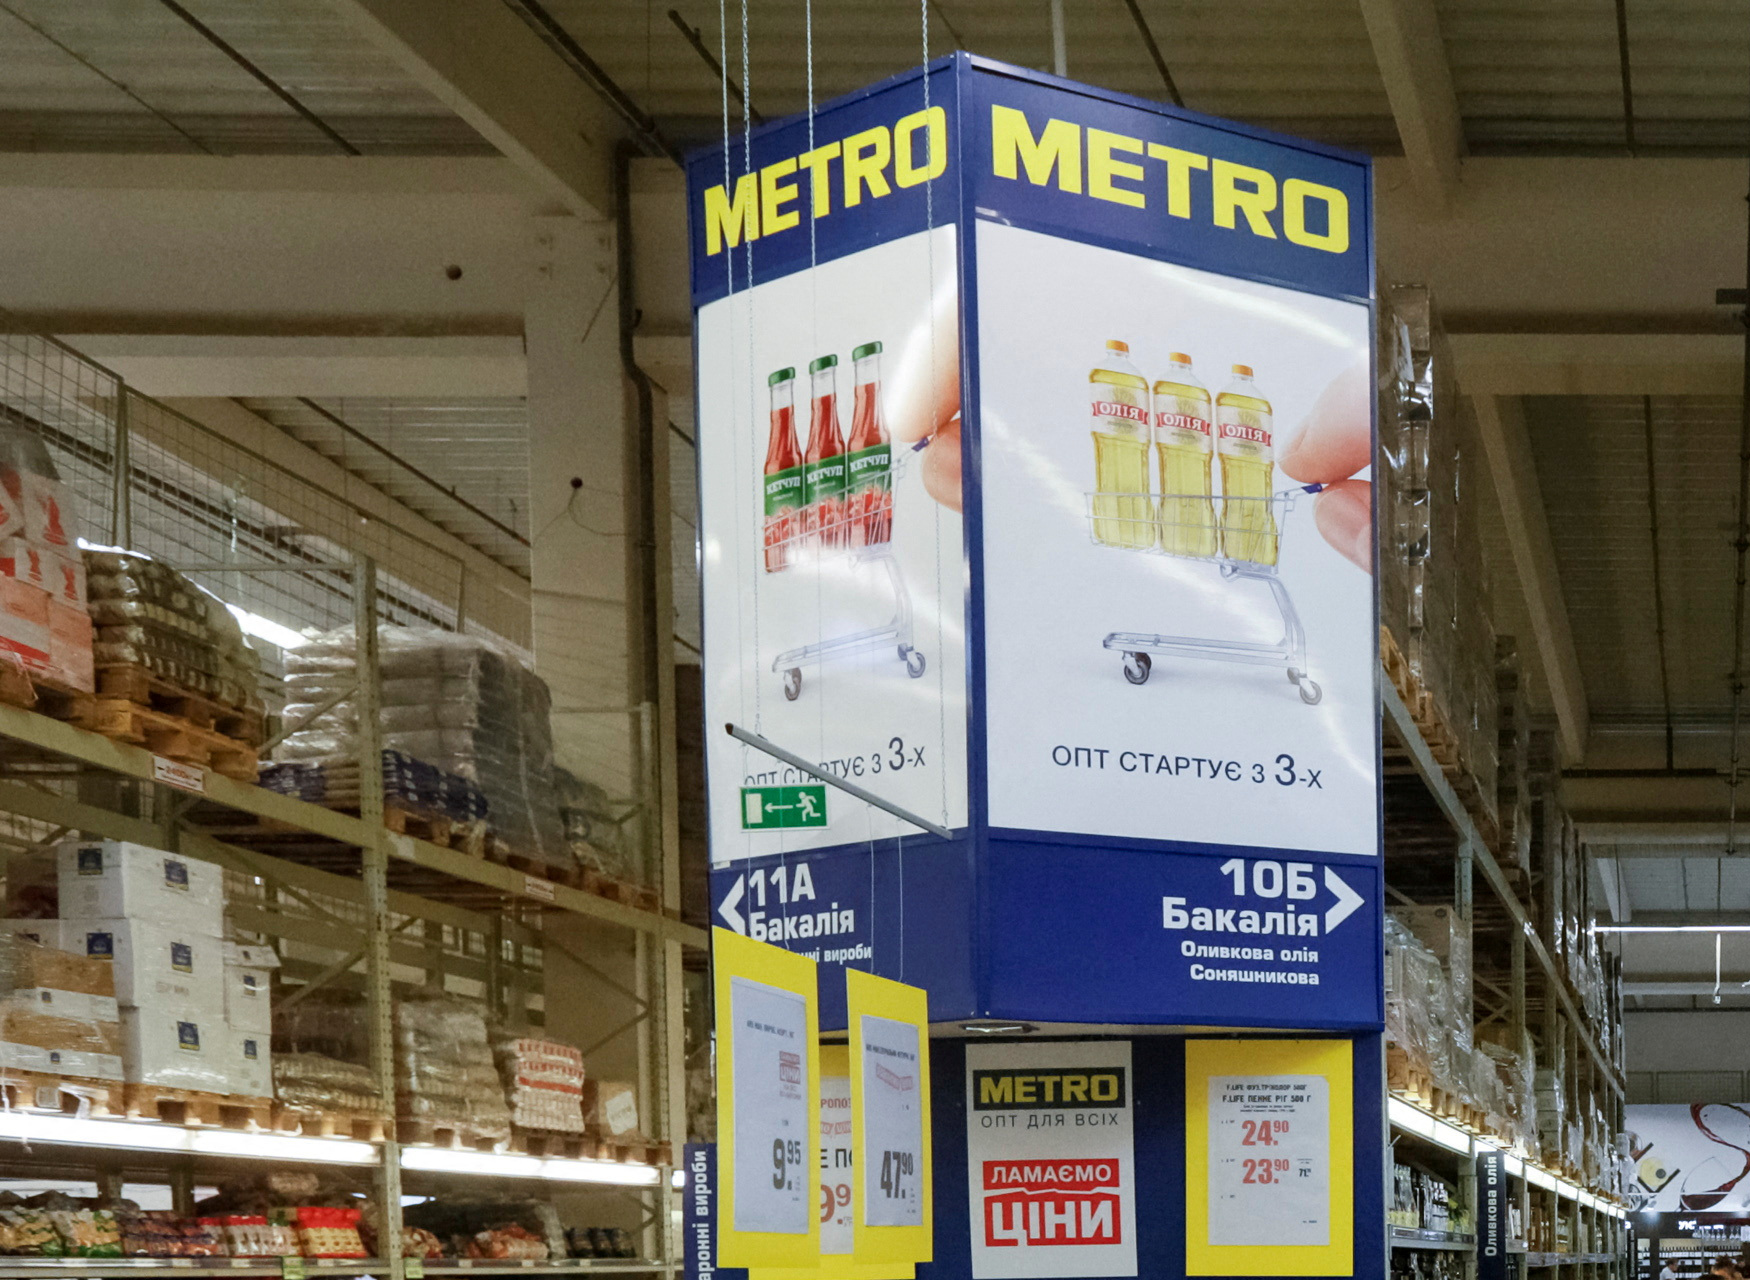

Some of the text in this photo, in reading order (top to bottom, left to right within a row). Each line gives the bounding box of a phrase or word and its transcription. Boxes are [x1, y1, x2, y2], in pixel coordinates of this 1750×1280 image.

[703, 106, 946, 256] METRO
[992, 104, 1349, 254] METRO
[1099, 402, 1140, 420] ОЛІЯ
[1163, 413, 1203, 431] ОЛІЯ
[1225, 425, 1263, 442] ОЛІЯ
[806, 465, 844, 484] КЕТЧУП
[850, 454, 889, 472] КЕТЧУП
[766, 476, 800, 495] КЕТЧУП
[1052, 745, 1110, 770] ОПТ
[1119, 751, 1242, 782] СТАРТУЄ
[749, 862, 817, 907] 11А
[1219, 857, 1318, 901] 10Б
[749, 902, 855, 943] Бакалія
[1162, 895, 1319, 937] Бакалія
[823, 943, 872, 966] вироби
[1180, 939, 1320, 963] Оливкова олія
[1189, 963, 1320, 986] Соняшникова
[979, 1073, 1119, 1105] METRO
[981, 1112, 1119, 1130] ОПТ ДЛЯ ВСІХ
[691, 1150, 712, 1217] вироби
[990, 1163, 1112, 1184] ЛАМАЄМО
[1484, 1156, 1498, 1257] Оливкова олія
[991, 1199, 1114, 1247] ЦІНИ
